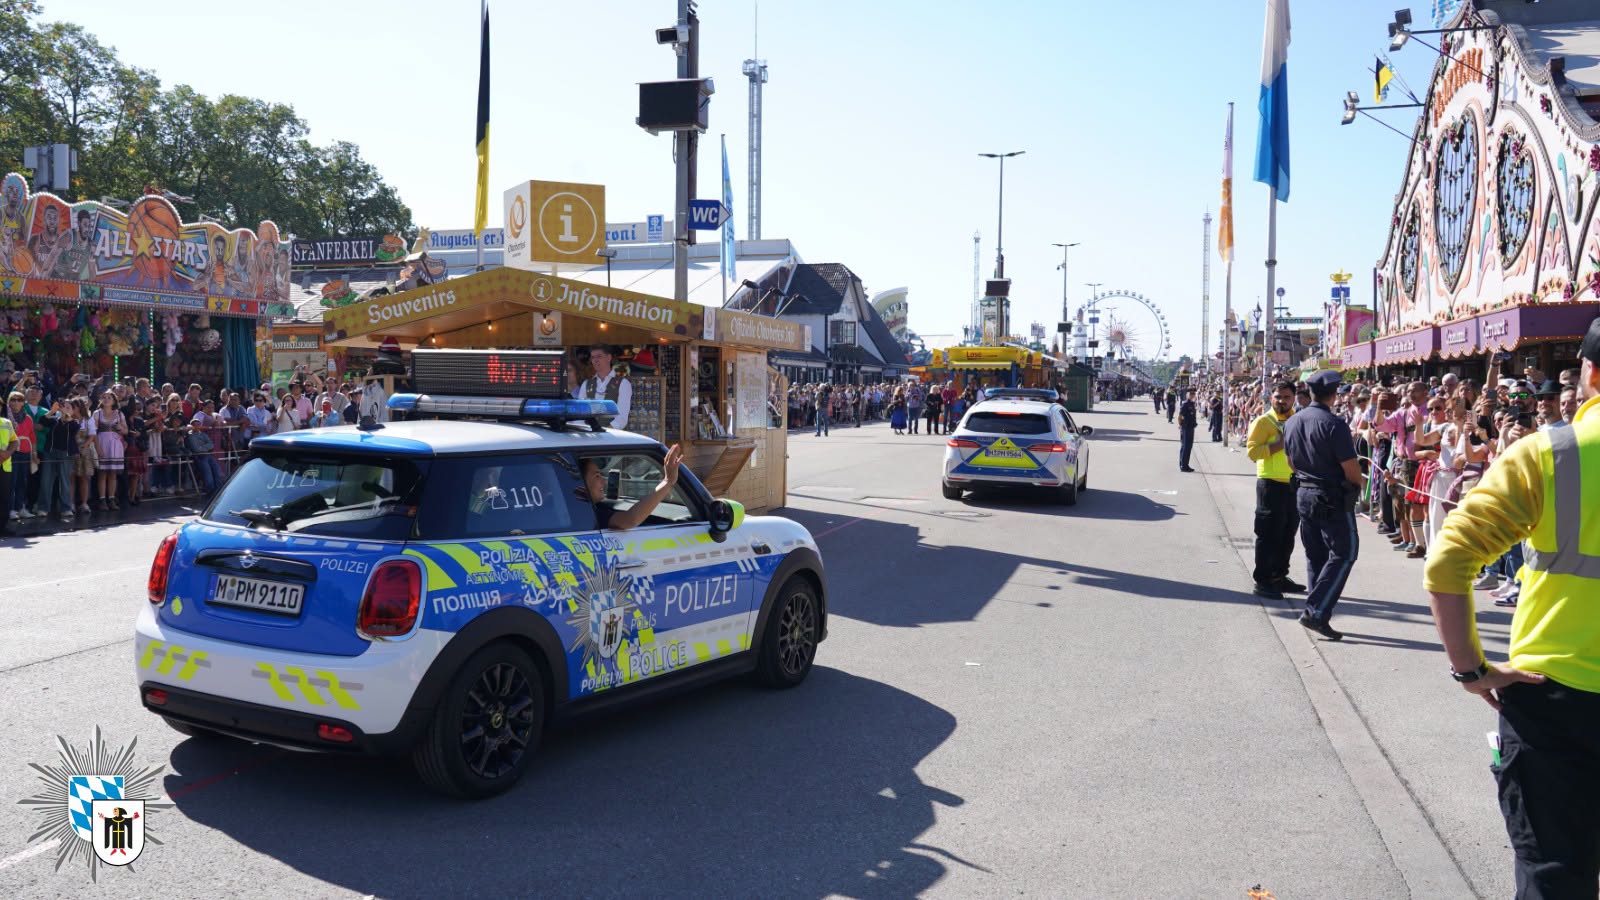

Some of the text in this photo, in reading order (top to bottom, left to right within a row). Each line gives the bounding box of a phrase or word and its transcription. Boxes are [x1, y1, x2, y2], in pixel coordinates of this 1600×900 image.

[692, 206, 718, 224] WC
[94, 228, 208, 270] ALL STARS
[367, 289, 456, 324] Souvenirs
[557, 283, 673, 325] Information
[510, 485, 543, 508] 110
[320, 558, 369, 575] POLIZEI
[480, 548, 536, 566] POLIZIA
[543, 550, 574, 573] 警察
[215, 578, 228, 599] M
[258, 584, 299, 609] 9110
[432, 590, 501, 614] ПОЛІЦІЯ
[664, 574, 738, 617] POLIZEI
[629, 641, 687, 680] POLICE
